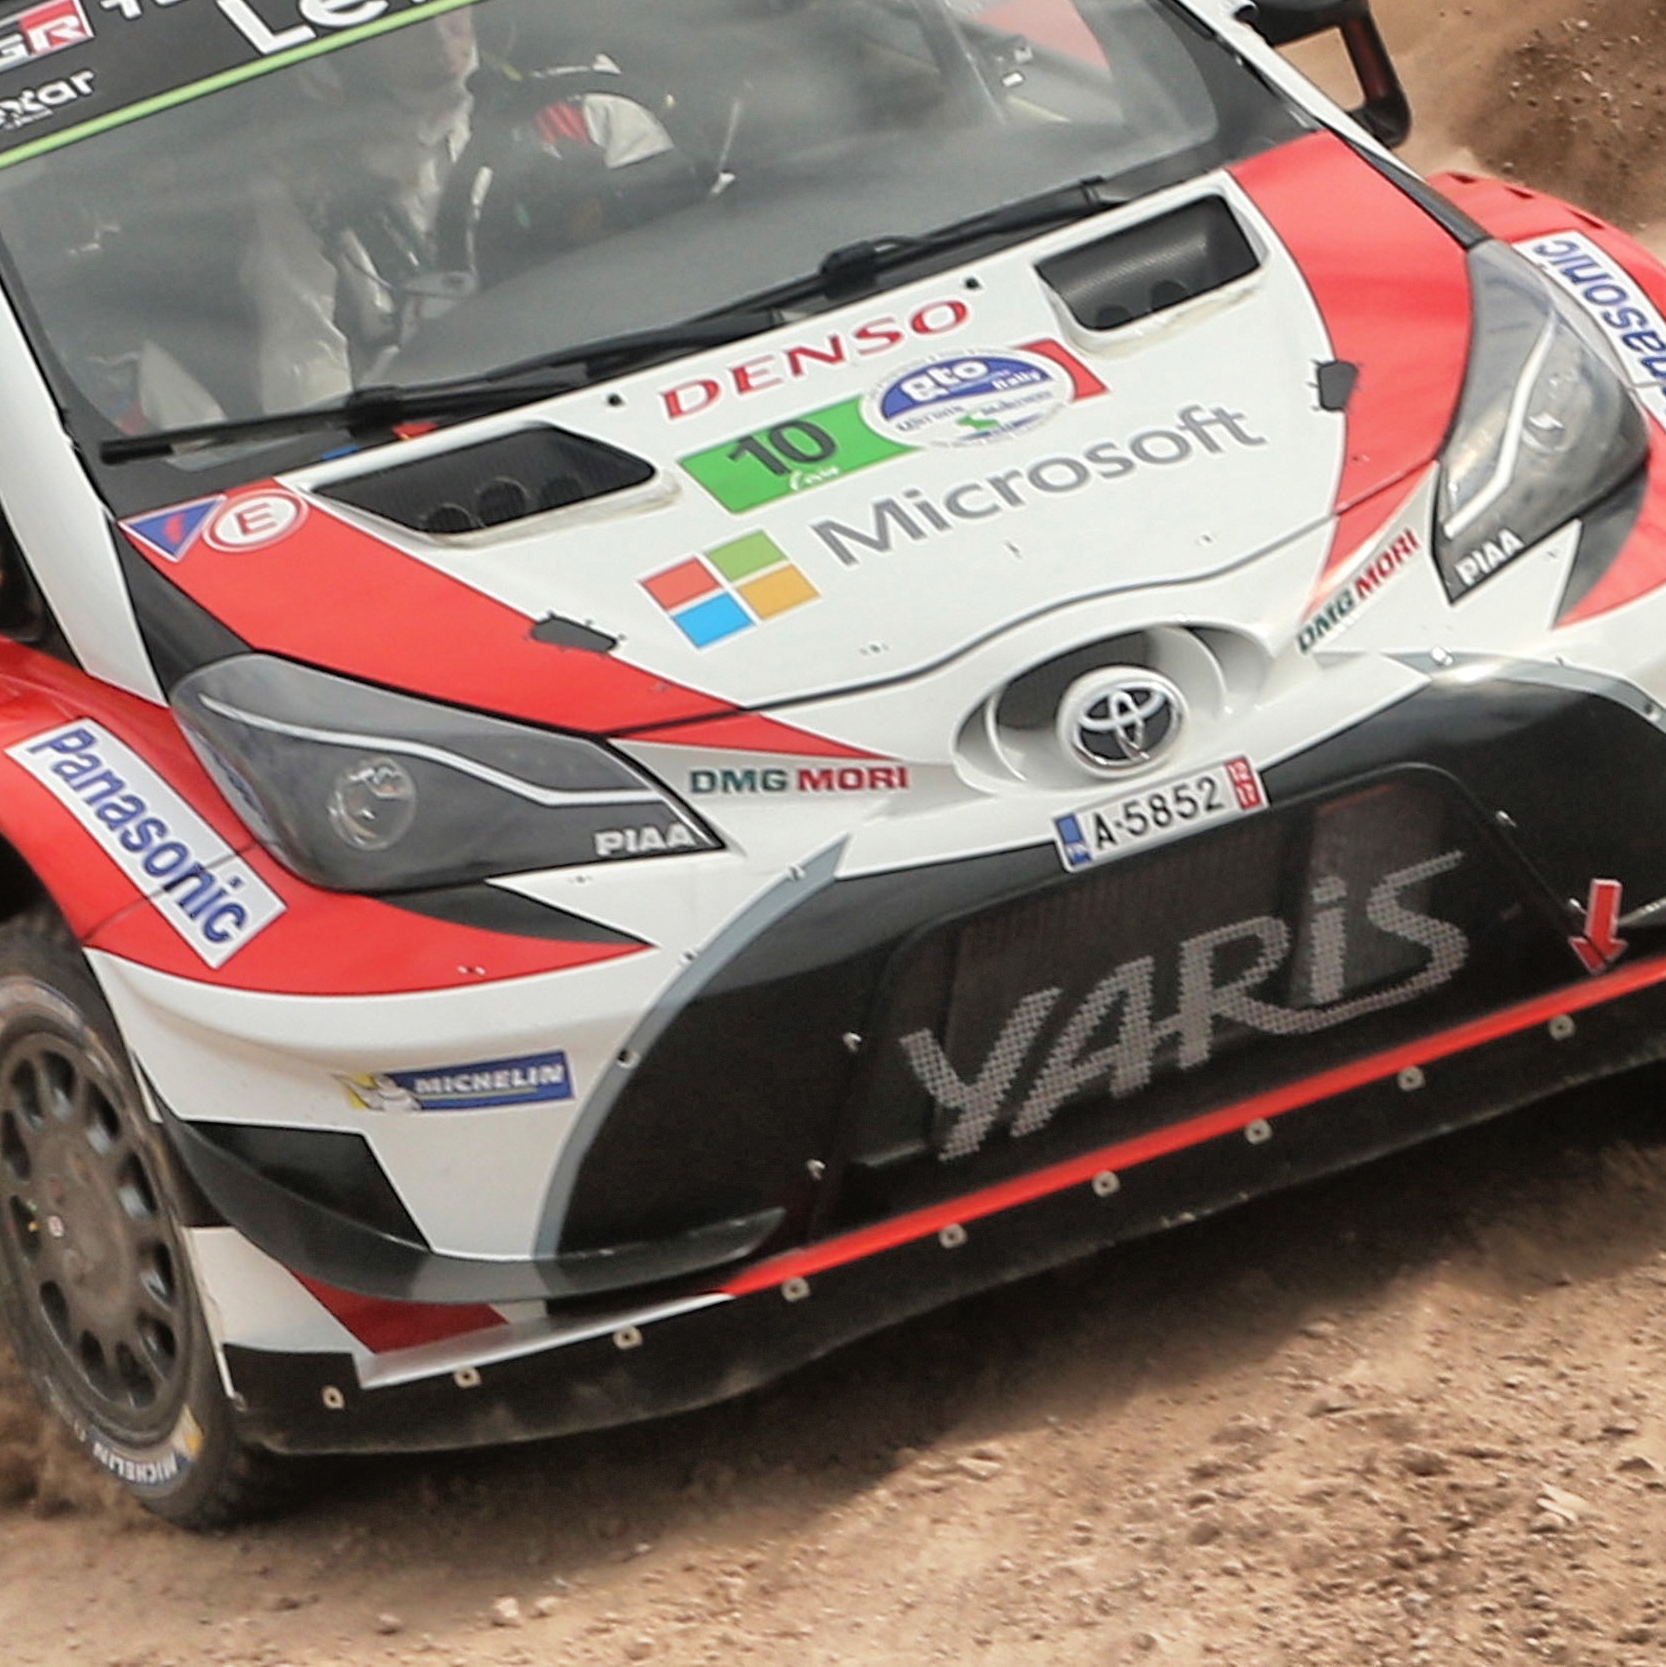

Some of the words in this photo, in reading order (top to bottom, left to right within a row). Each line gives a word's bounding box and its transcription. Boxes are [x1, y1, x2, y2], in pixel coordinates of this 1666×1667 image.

[658, 299, 972, 421] DENSO
[900, 358, 988, 402] gto
[728, 420, 837, 476] 10
[809, 403, 1268, 567] Microsoft
[235, 501, 278, 537] E
[1455, 528, 1525, 586] PIAA
[1296, 587, 1355, 655] DMG
[1354, 527, 1420, 601] MORI
[689, 769, 788, 794] DMG
[796, 766, 910, 791] MORI
[25, 727, 250, 945] Panasonic
[594, 823, 697, 857] PIAA
[1092, 775, 1225, 851] A-5852
[415, 1063, 565, 1094] MICHELIN
[92, 1441, 179, 1484] MICHELIN
